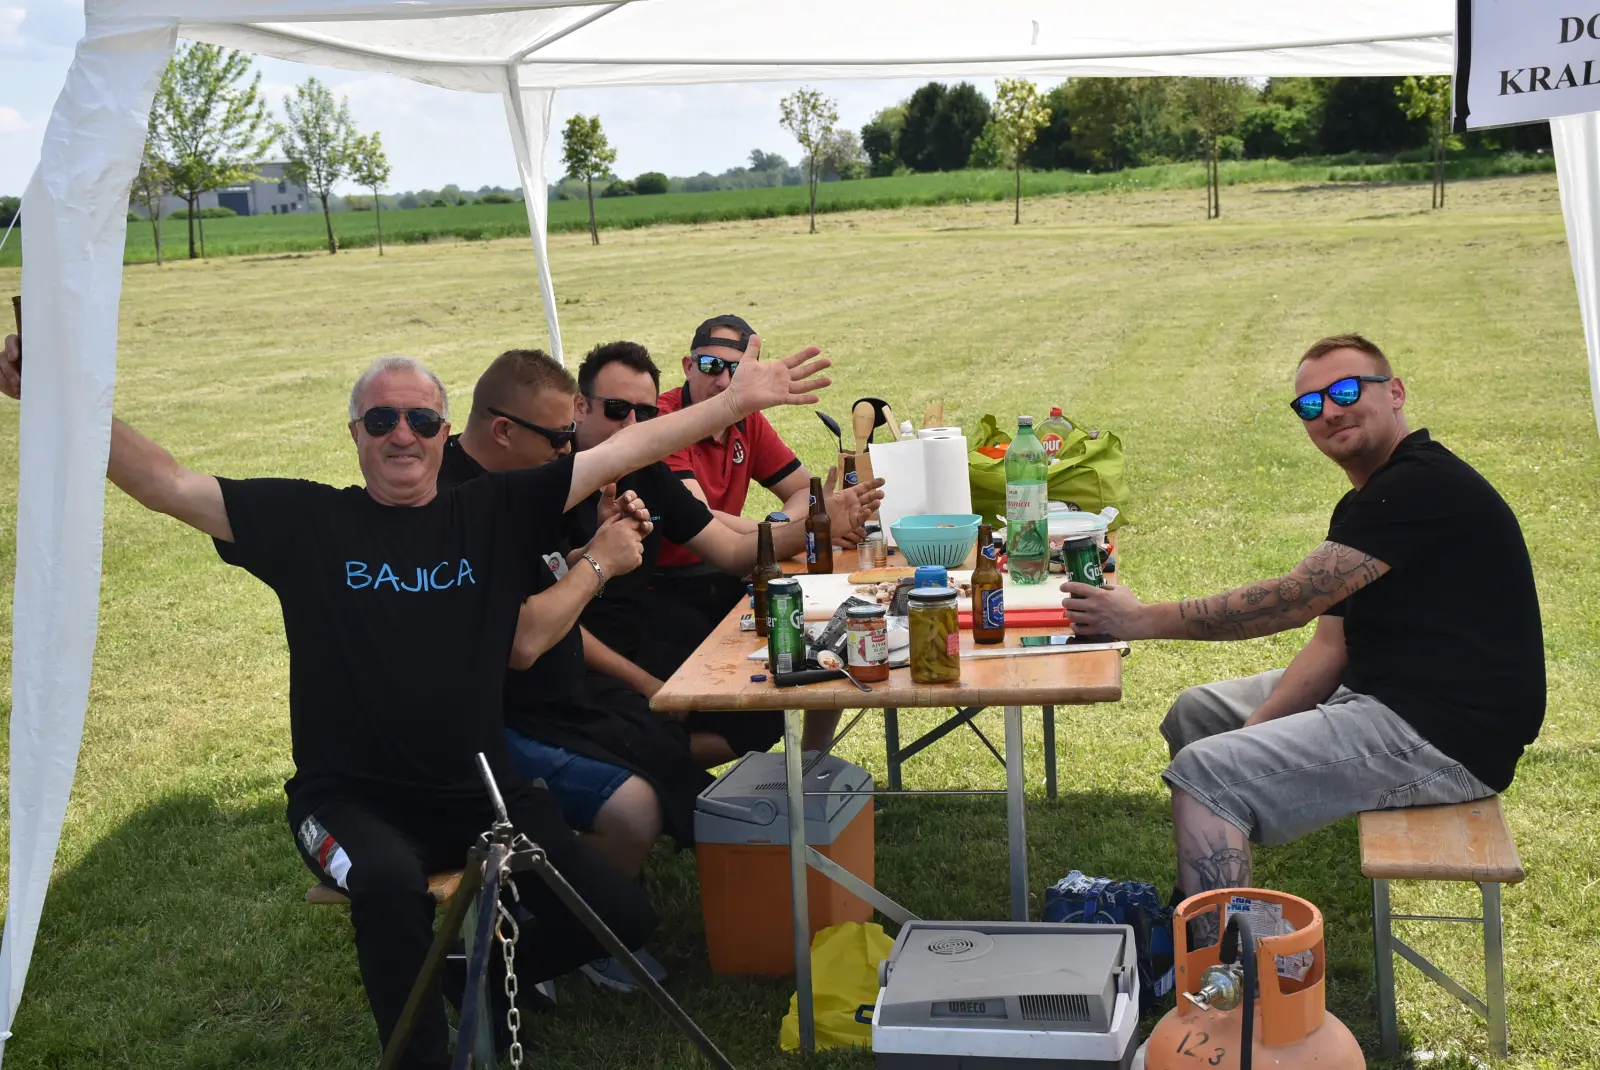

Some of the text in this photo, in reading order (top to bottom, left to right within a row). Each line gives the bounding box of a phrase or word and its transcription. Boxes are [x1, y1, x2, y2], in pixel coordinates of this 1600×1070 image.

[1497, 60, 1600, 96] KRAL
[345, 557, 476, 593] BAJICA
[948, 1001, 986, 1014] WAECO
